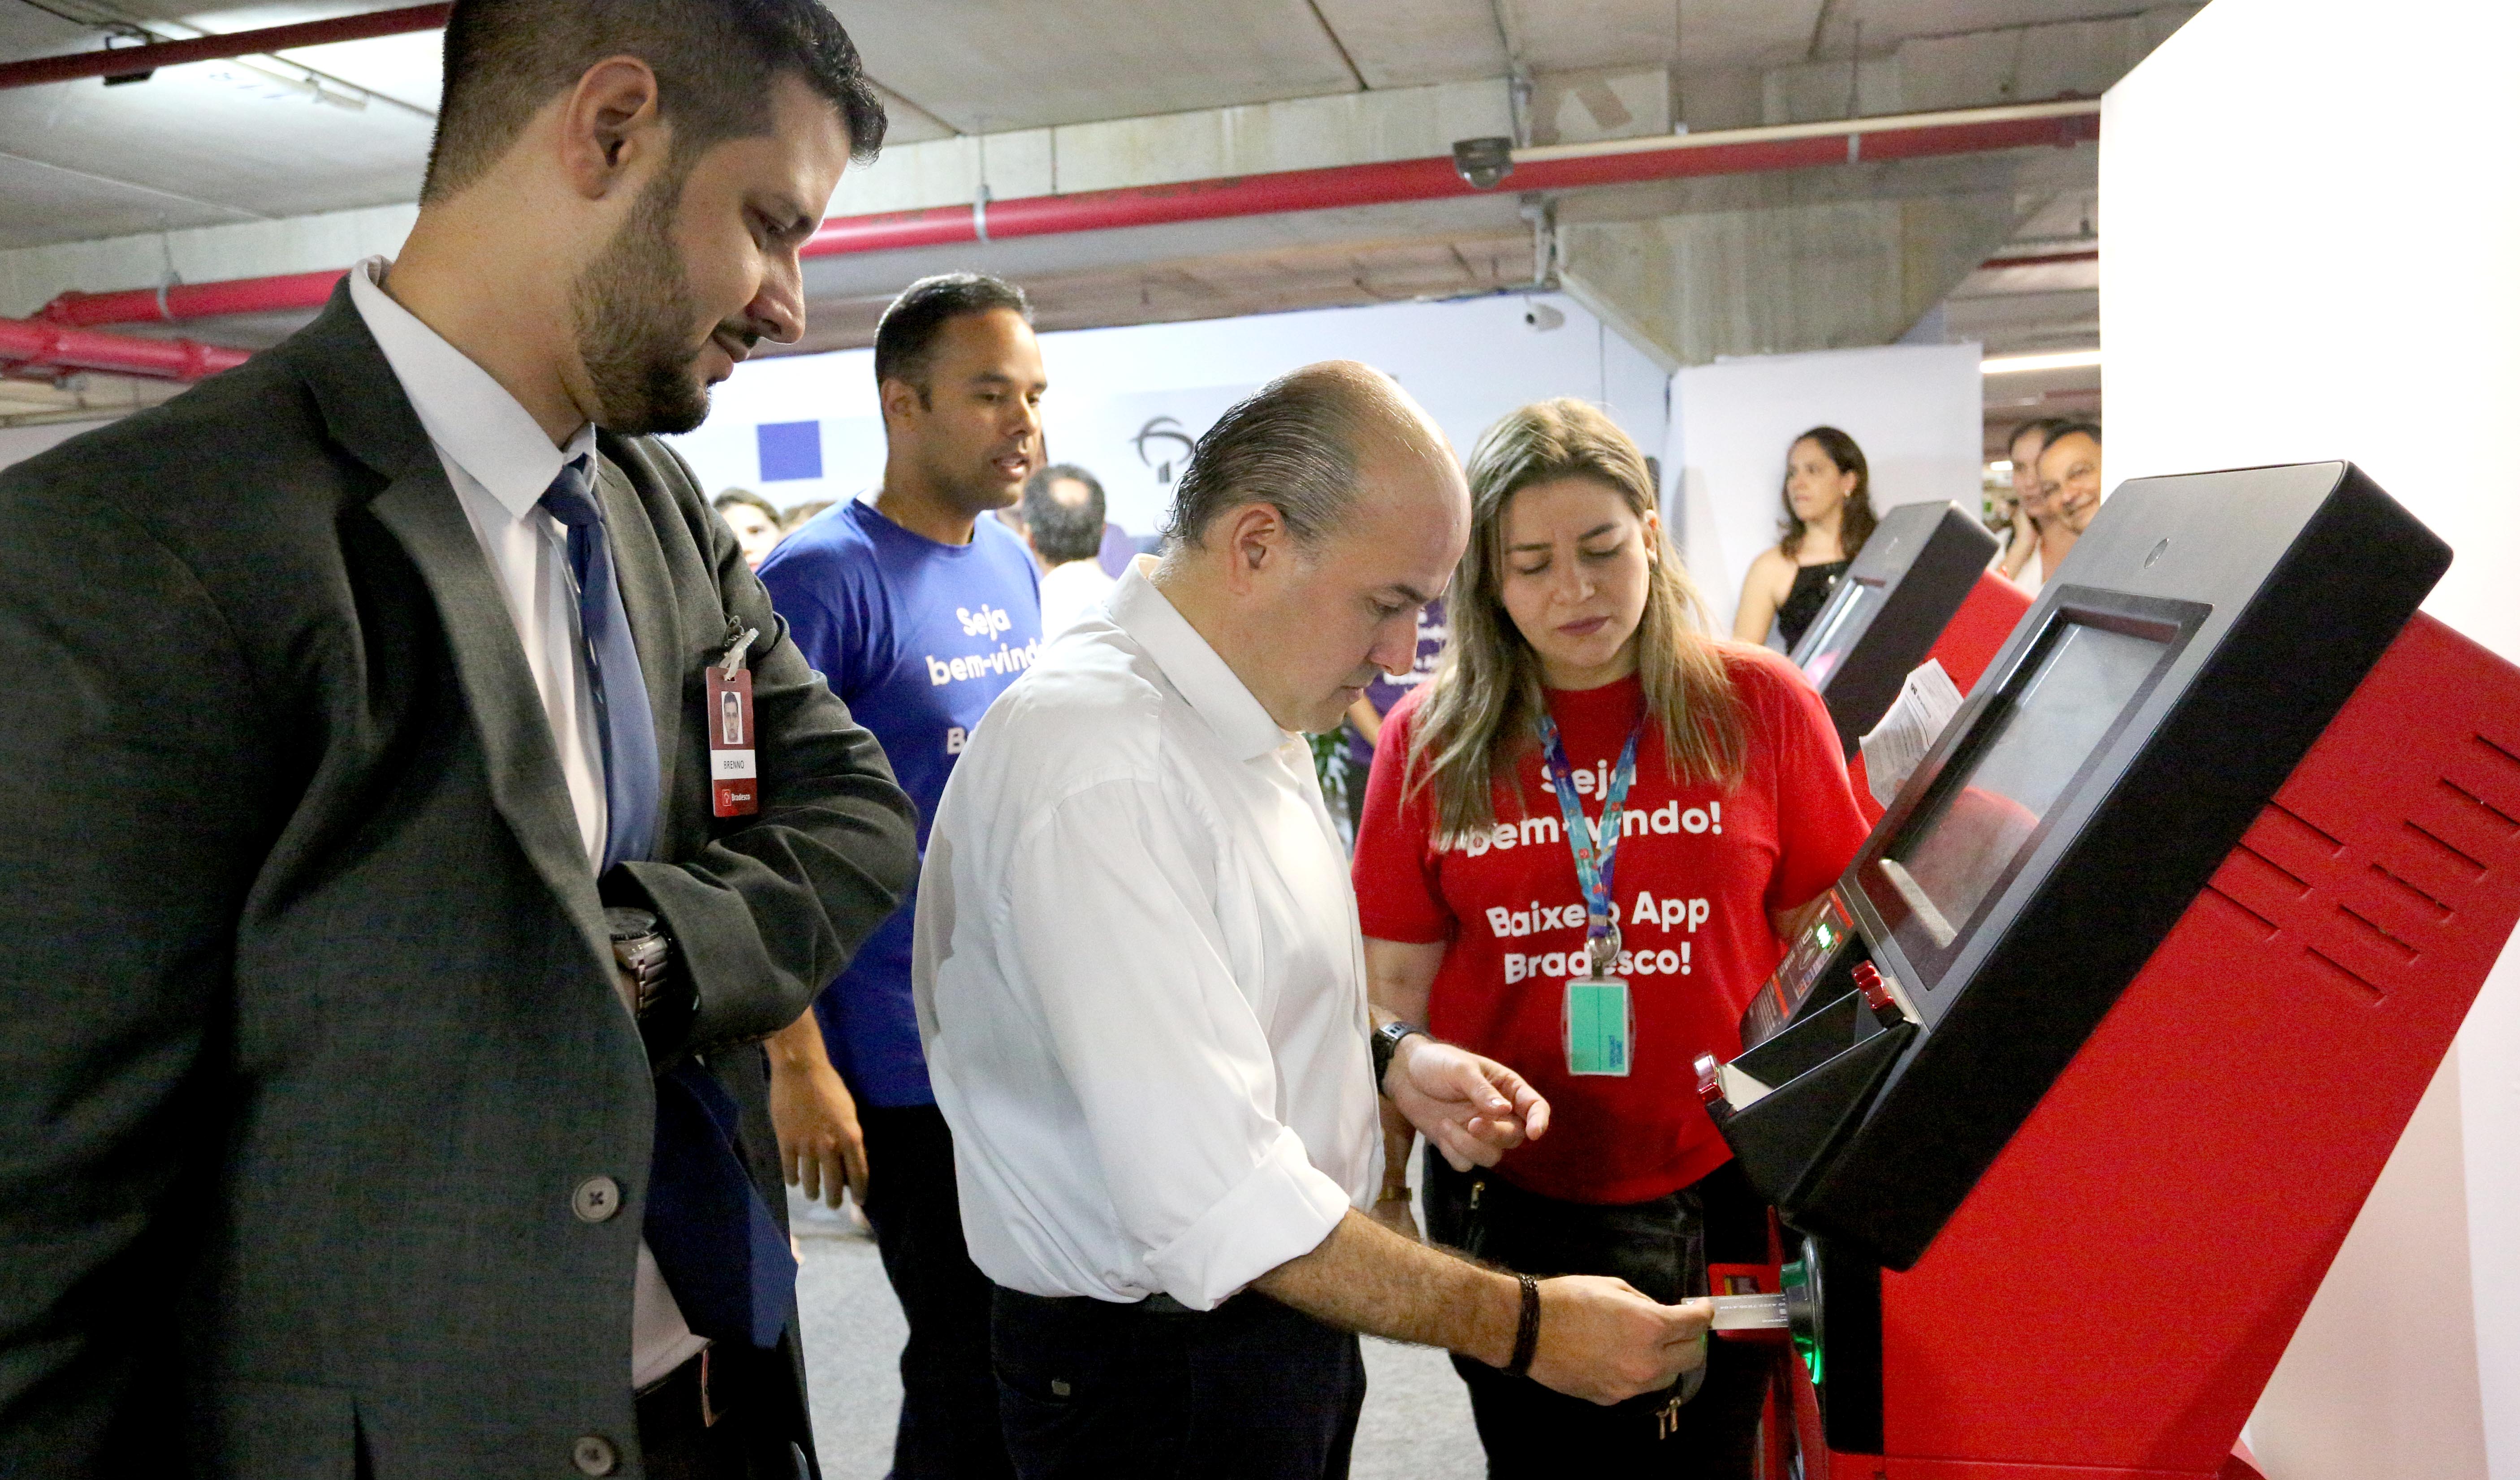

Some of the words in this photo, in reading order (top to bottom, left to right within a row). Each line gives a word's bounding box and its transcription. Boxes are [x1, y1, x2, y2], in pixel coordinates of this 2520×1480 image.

[956, 604, 1011, 641] Seja
[925, 637, 1045, 686] bem-vind
[723, 760, 744, 769] BRENNO
[731, 793, 751, 801] Bradesco
[1466, 800, 1722, 858] bemvndo!
[1485, 900, 1586, 938] Baixe
[1631, 891, 1710, 933] App
[1504, 941, 1691, 984] Bradsco!
